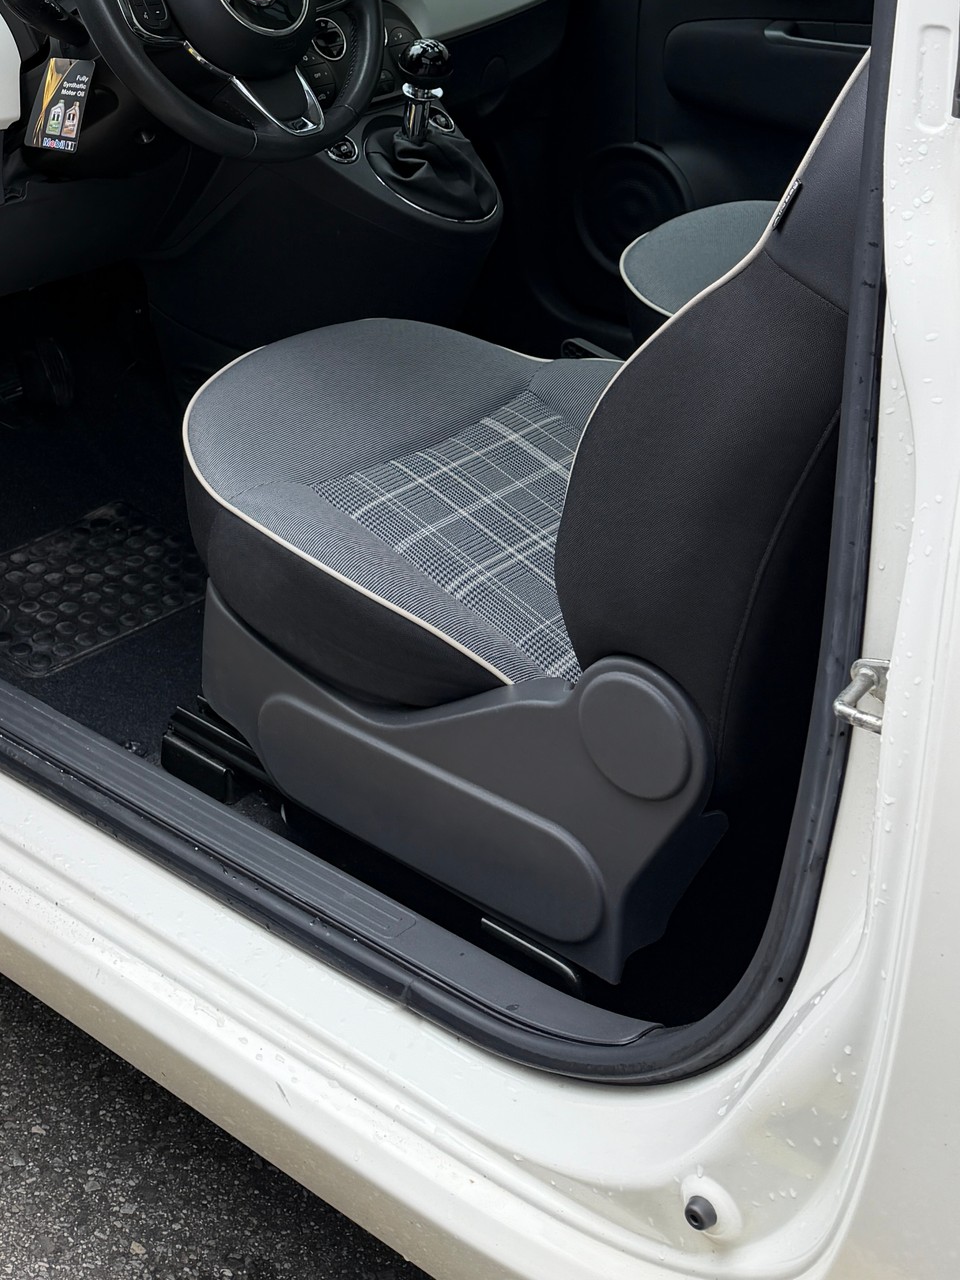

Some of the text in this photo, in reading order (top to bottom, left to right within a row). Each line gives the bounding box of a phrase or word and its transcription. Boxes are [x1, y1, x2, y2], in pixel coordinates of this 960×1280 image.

[76, 74, 89, 83] Fully
[62, 81, 87, 90] Synthetic
[60, 88, 85, 97] Motor Oil
[42, 137, 66, 150] Mobil
